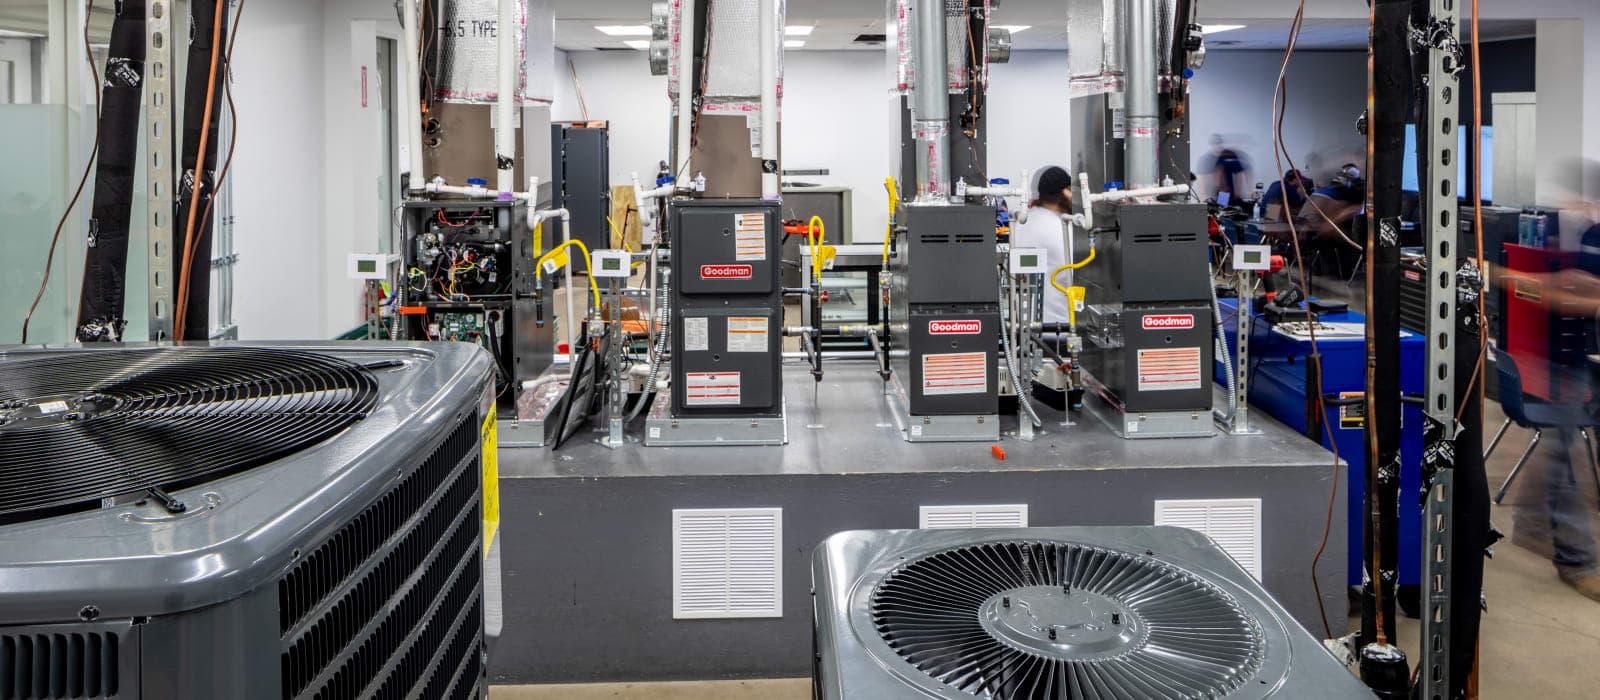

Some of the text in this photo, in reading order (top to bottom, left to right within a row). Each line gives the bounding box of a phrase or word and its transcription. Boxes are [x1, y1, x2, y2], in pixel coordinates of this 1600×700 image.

[471, 20, 497, 37] TYPE
[703, 266, 750, 276] Goodman
[1144, 316, 1192, 326] Goodman
[931, 322, 979, 331] Goodman
